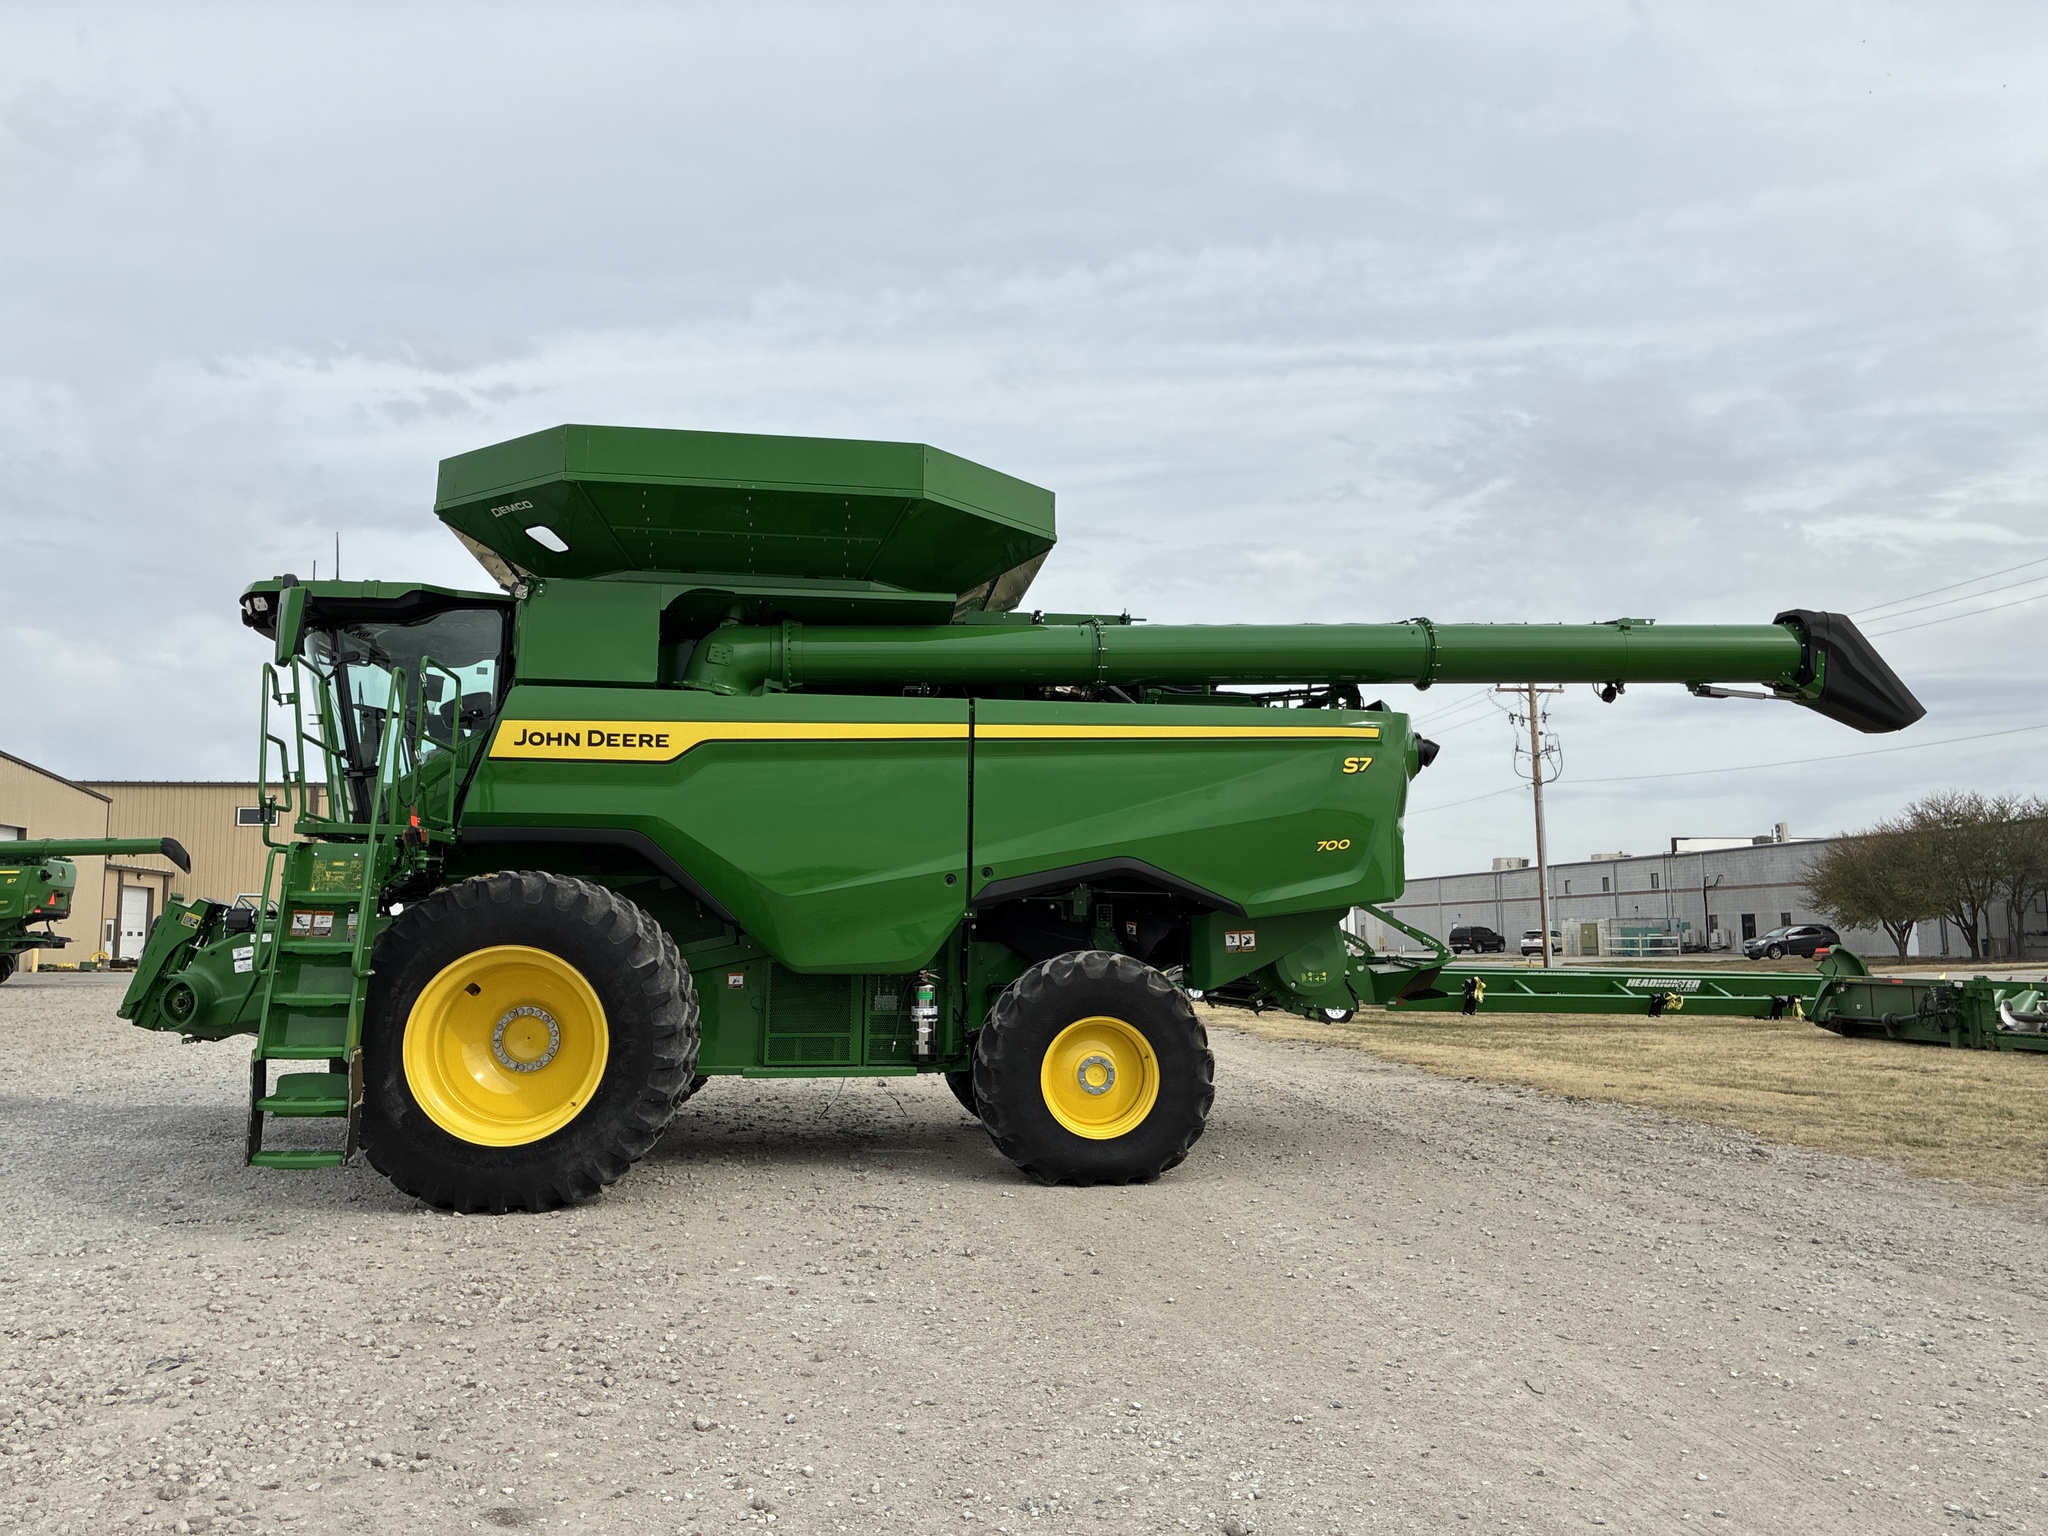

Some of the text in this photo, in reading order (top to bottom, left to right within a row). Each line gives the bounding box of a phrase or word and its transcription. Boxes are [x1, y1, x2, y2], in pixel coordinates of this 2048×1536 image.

[490, 500, 534, 518] DEMCO
[514, 729, 669, 748] JOHN DEERE
[1342, 756, 1374, 775] S7
[1315, 838, 1351, 853] 700
[1625, 978, 1702, 988] HEADHUNTER
